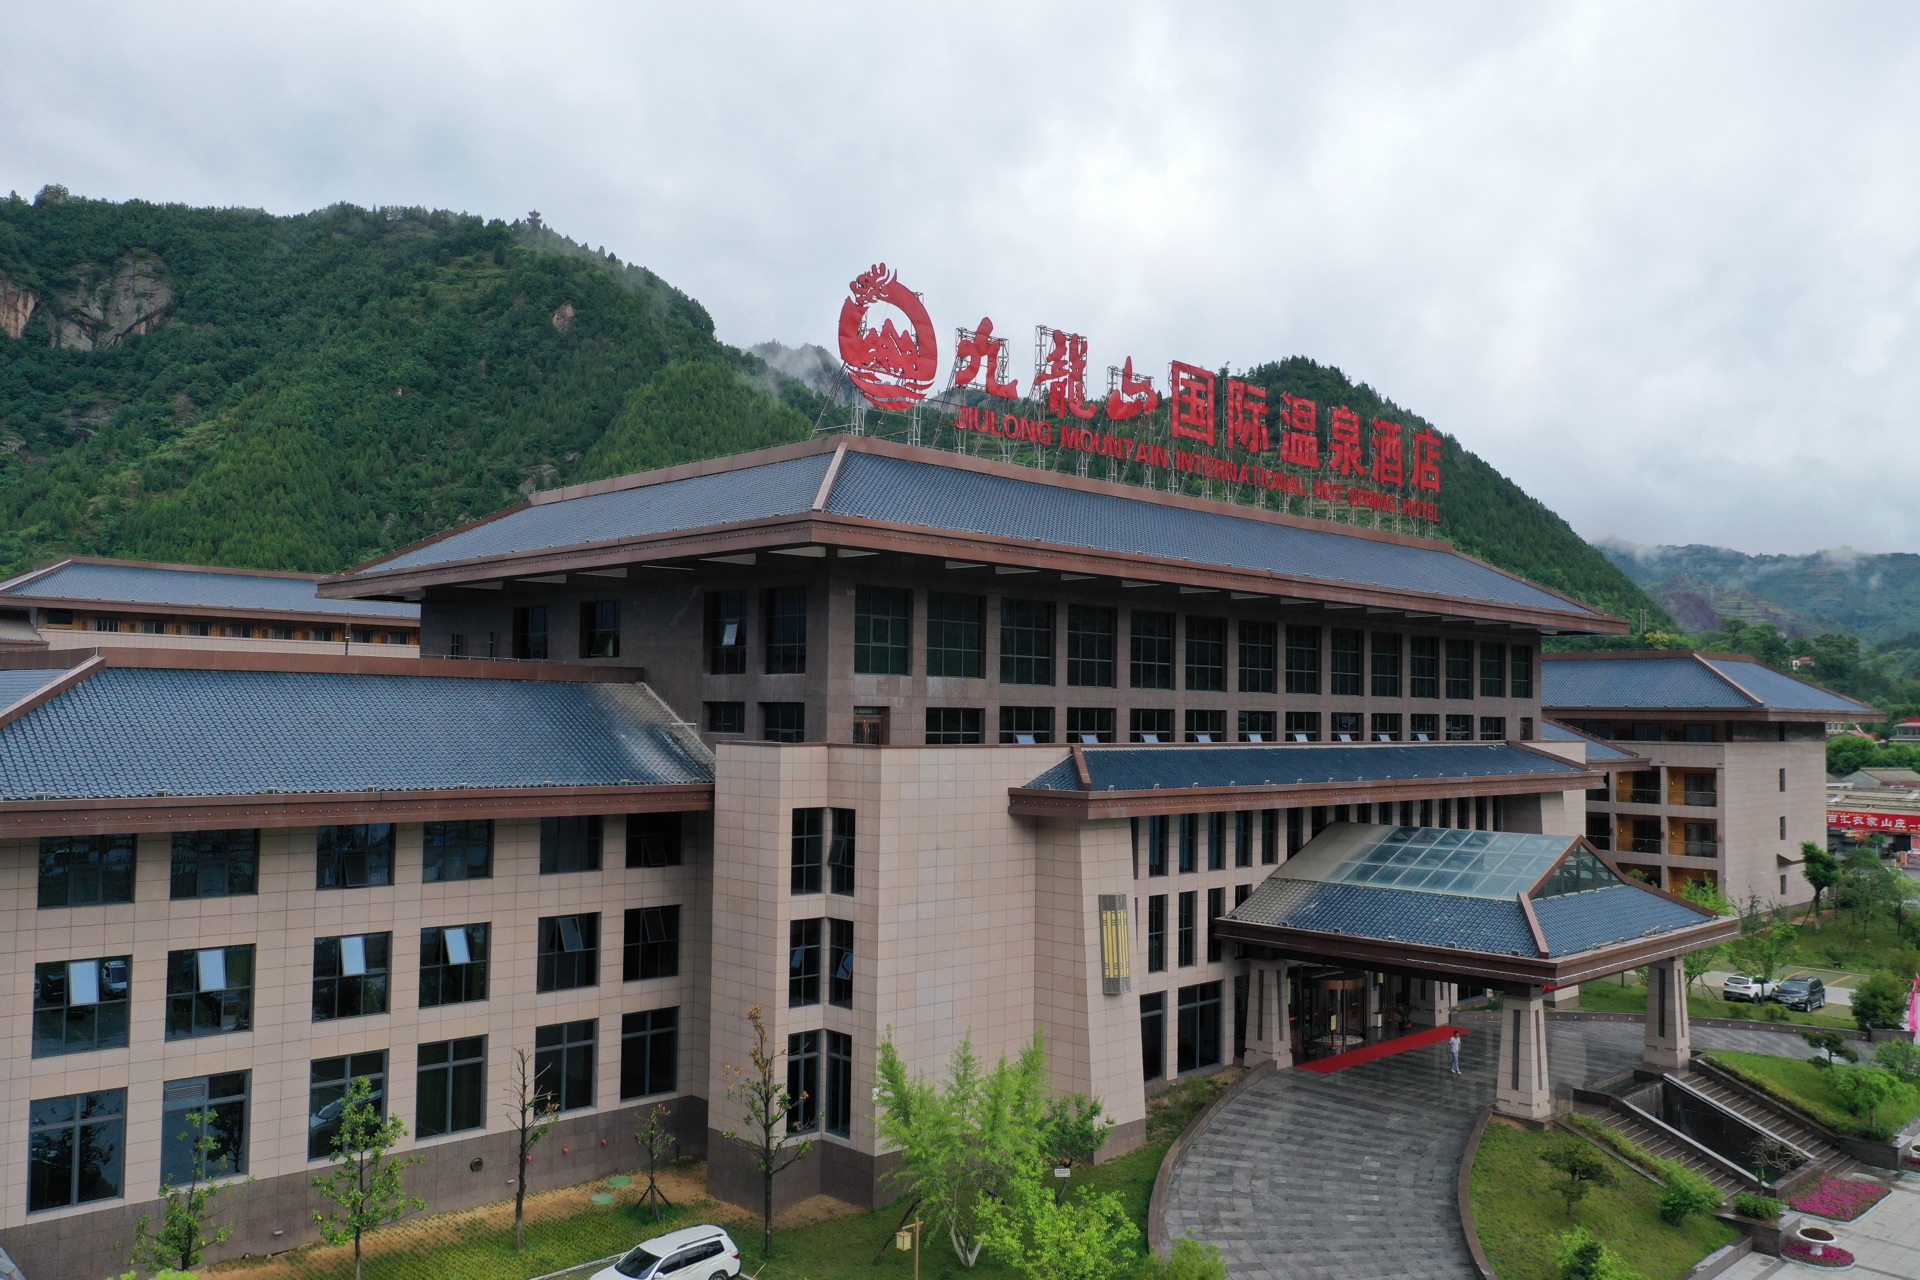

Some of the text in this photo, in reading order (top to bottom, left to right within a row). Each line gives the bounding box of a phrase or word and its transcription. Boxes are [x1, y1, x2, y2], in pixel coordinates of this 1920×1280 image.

[954, 405, 1441, 522] JIULONG MOUNTAIN INTERNATIONAL HOT SPRING HOTEL
